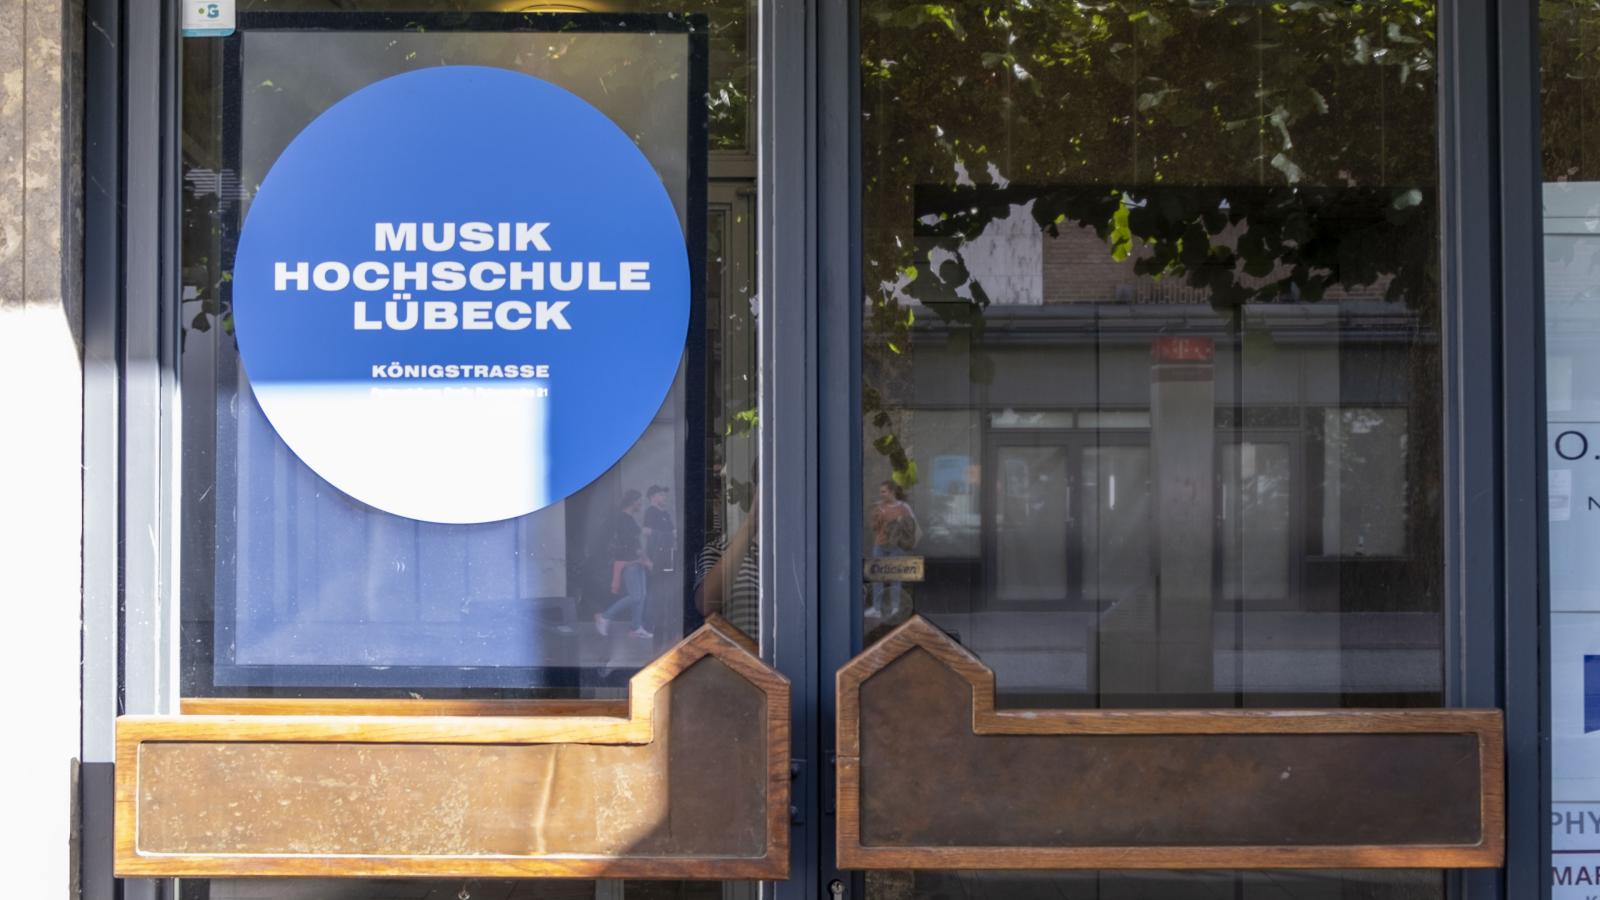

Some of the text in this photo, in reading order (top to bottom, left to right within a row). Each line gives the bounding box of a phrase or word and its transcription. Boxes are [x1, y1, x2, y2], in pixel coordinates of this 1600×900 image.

[375, 221, 552, 252] MUSIK
[274, 261, 651, 292] HOCHSCHULE
[353, 293, 572, 331] LÜBECK
[371, 362, 550, 378] KÖNIGSTRASSE
